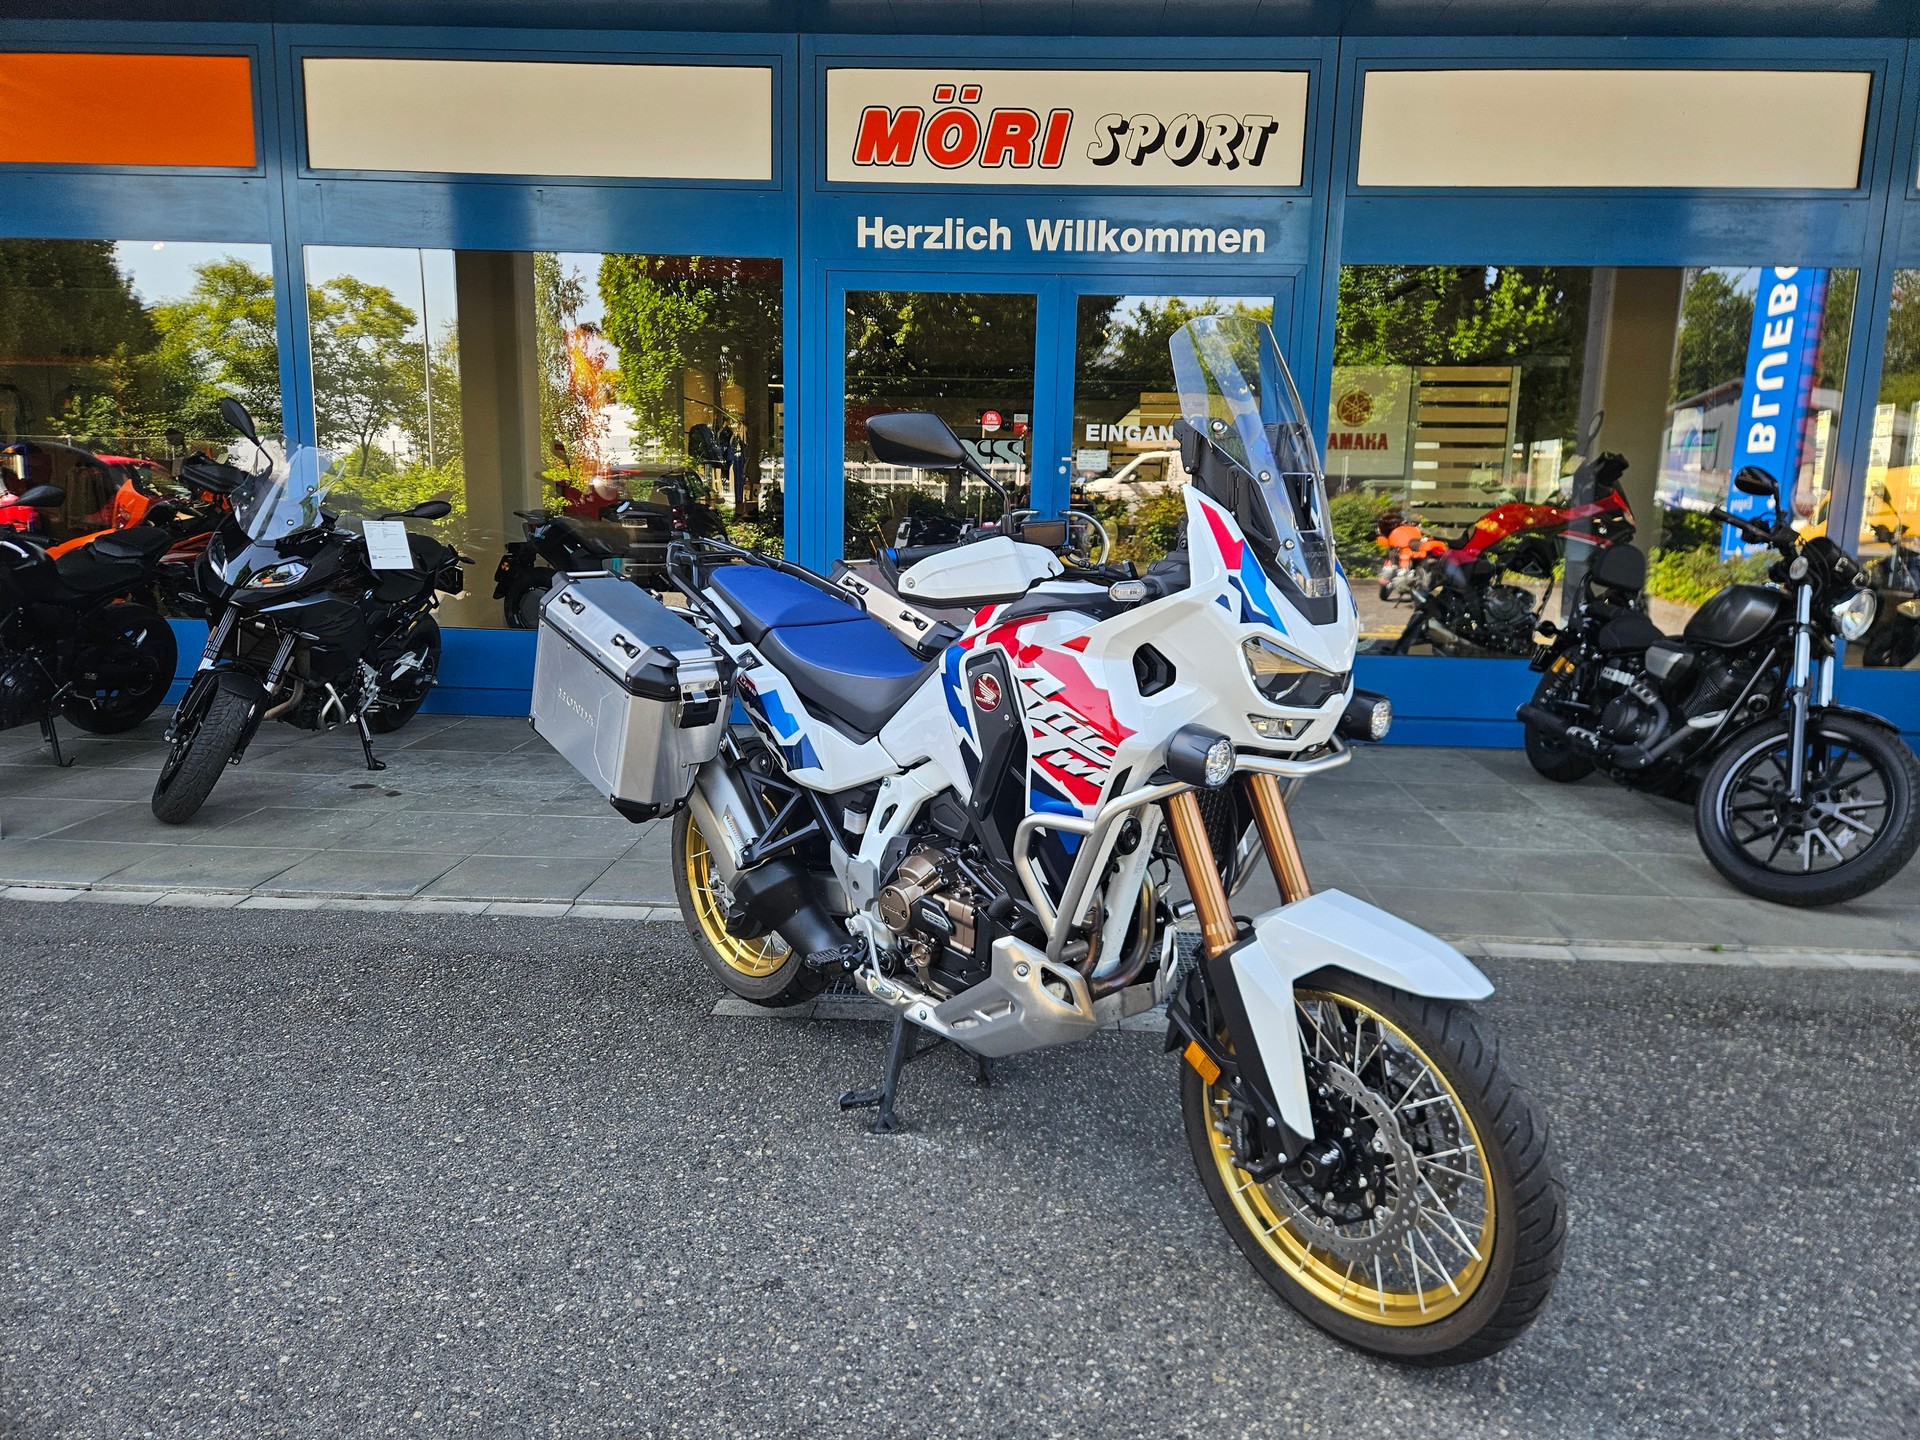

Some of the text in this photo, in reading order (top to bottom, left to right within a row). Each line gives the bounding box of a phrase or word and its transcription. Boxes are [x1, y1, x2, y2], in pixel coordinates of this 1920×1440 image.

[852, 84, 1279, 171] MÖRI SPORT
[857, 216, 1265, 253] Herzlich Willkommen
[1085, 424, 1174, 442] EINGAN
[1327, 432, 1388, 450] AMAHA
[558, 688, 596, 729] HONDA
[975, 695, 996, 706] HONDA
[1012, 664, 1118, 763] Afric
